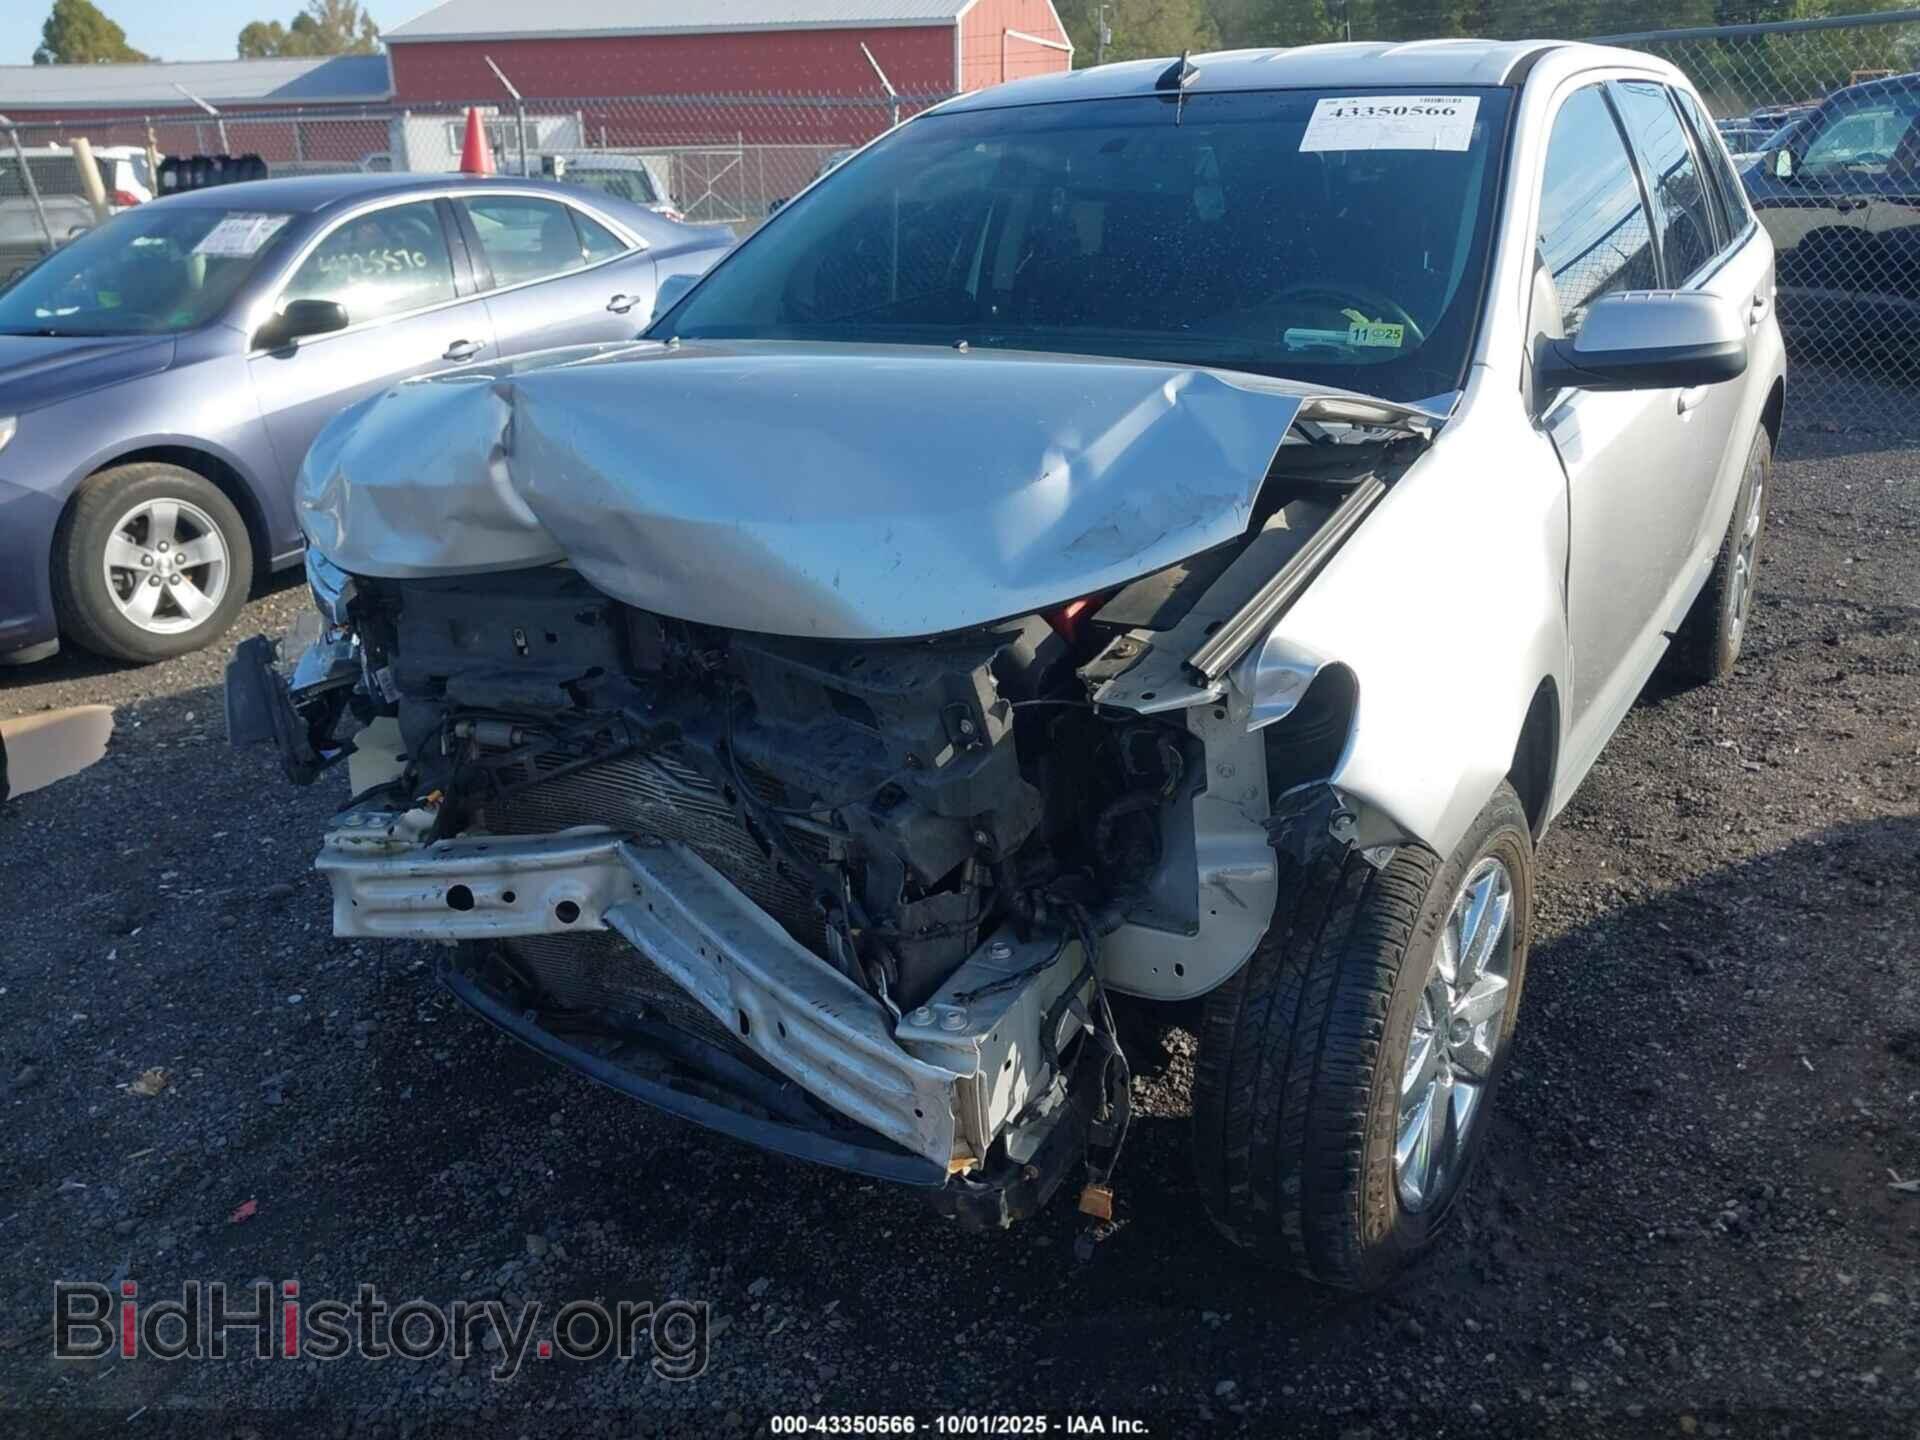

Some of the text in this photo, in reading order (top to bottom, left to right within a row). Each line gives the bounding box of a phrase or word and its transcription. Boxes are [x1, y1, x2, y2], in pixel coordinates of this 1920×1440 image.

[1329, 105, 1457, 118] 43350566
[1354, 328, 1401, 342] 11 25
